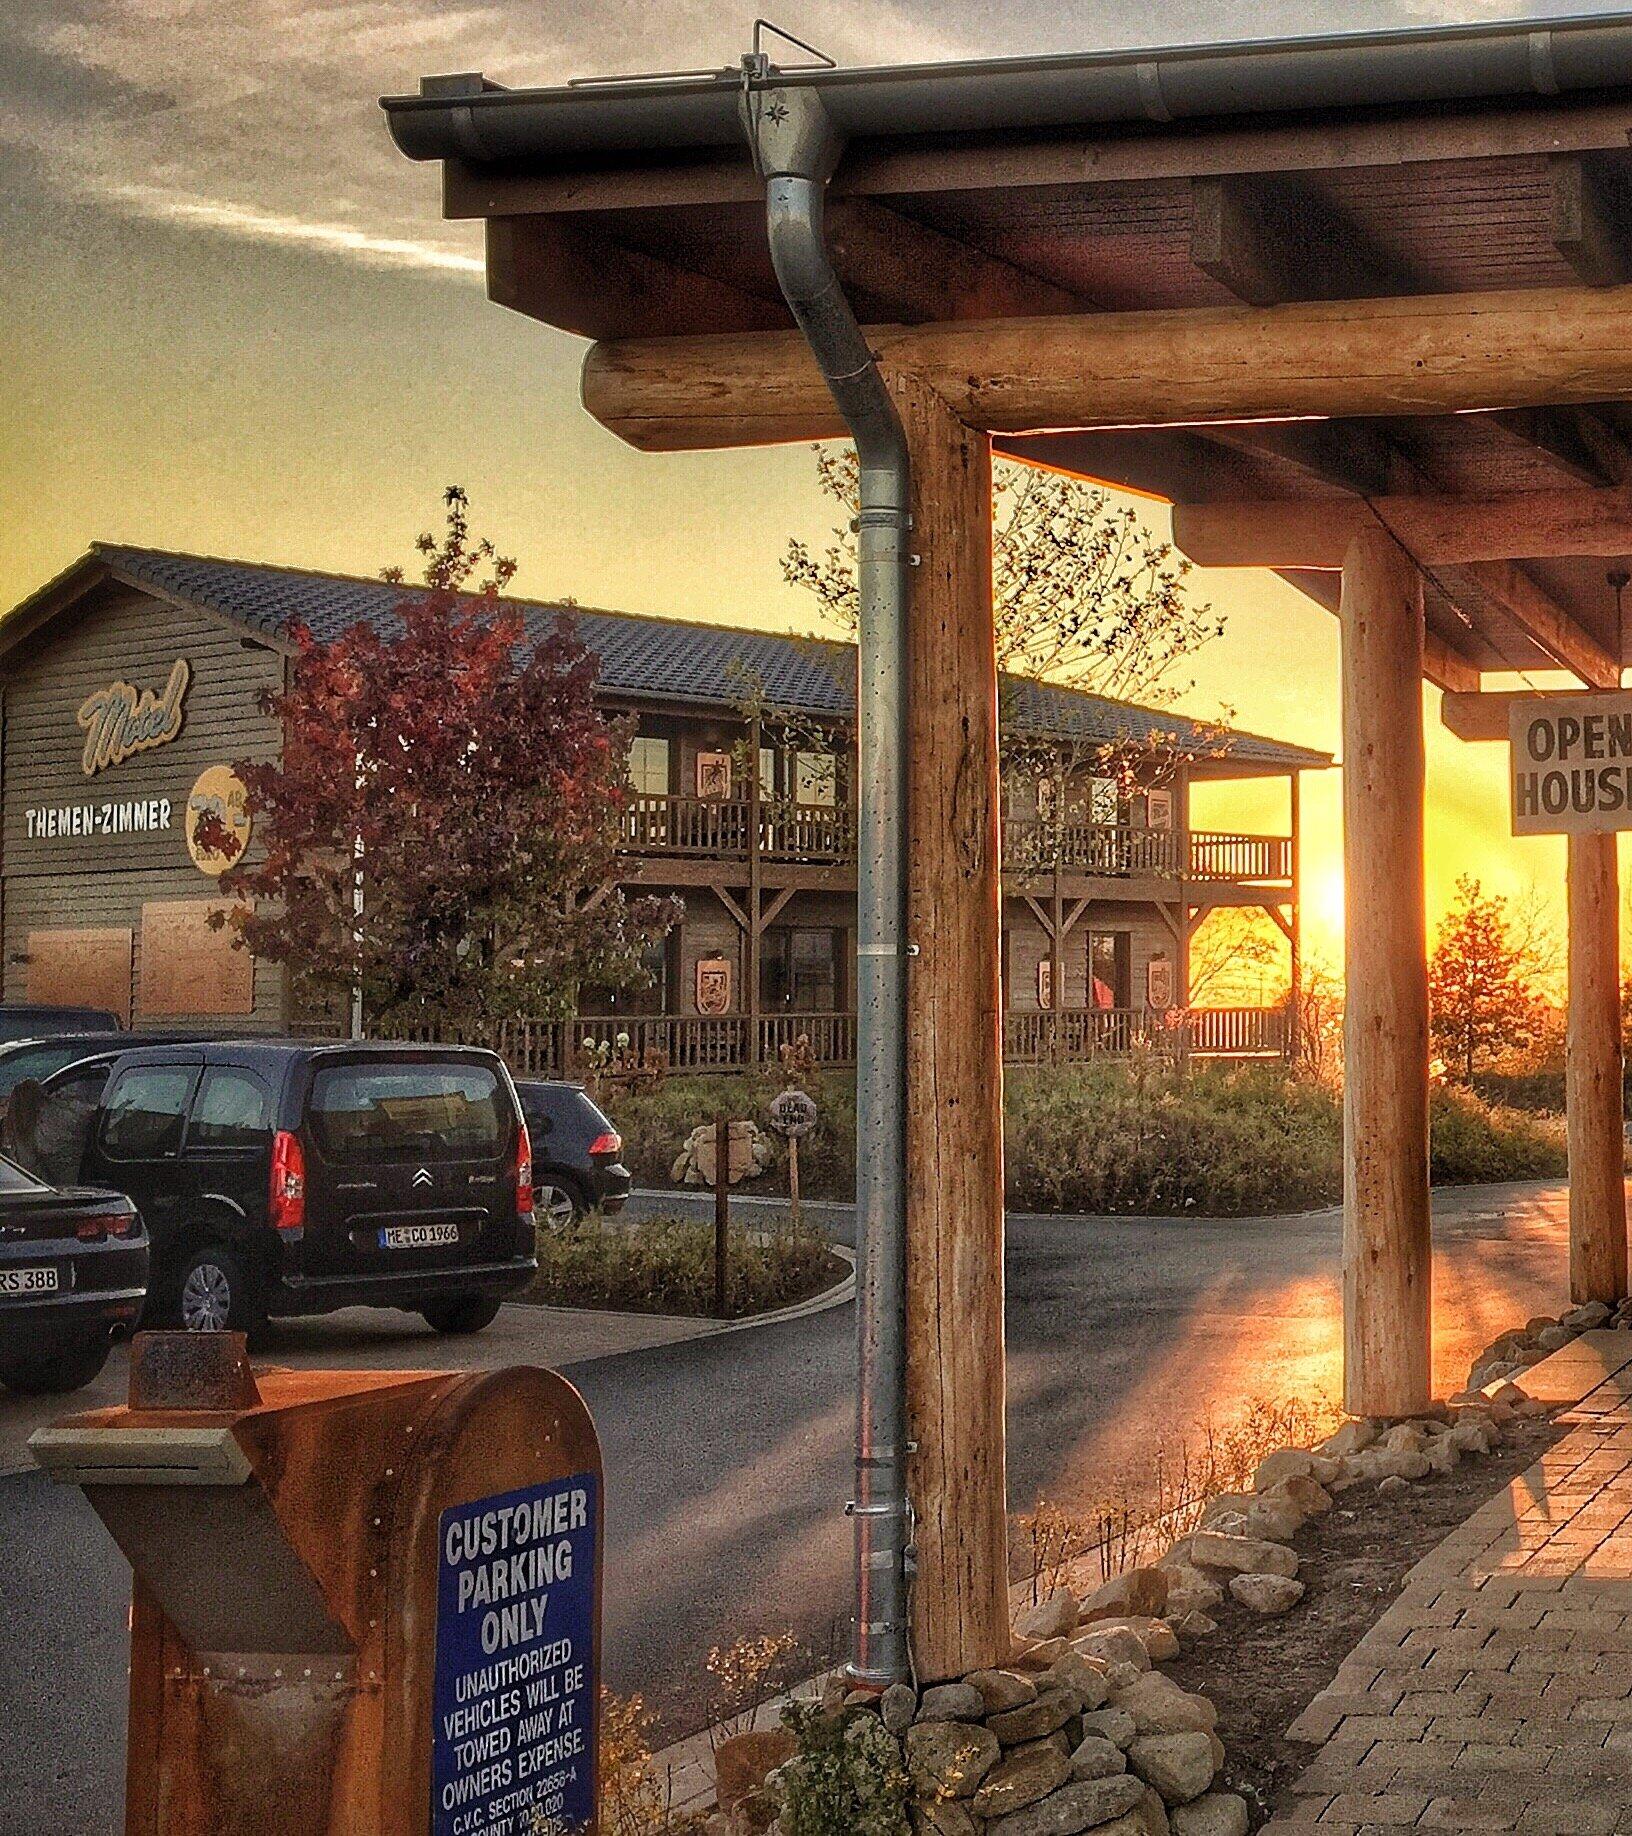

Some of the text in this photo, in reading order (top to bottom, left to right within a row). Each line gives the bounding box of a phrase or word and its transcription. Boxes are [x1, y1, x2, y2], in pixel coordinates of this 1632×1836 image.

[79, 660, 187, 774] Motel
[1527, 713, 1632, 762] OPEN
[25, 798, 171, 838] THEMEN-ZIMMER
[430, 1226, 458, 1241] 1966
[24, 1270, 56, 1289] 388
[446, 1489, 587, 1566] CUSTOMER
[458, 1540, 572, 1613] PARKING
[481, 1594, 548, 1655] ONLY
[444, 1664, 584, 1740] VEHICLES WILL BE
[455, 1638, 572, 1703] UNAUTHORIZED
[454, 1699, 575, 1771] TOWED AWAY AT
[442, 1728, 585, 1811] OWNERS EXPENSE.
[489, 1785, 534, 1820] SECTION
